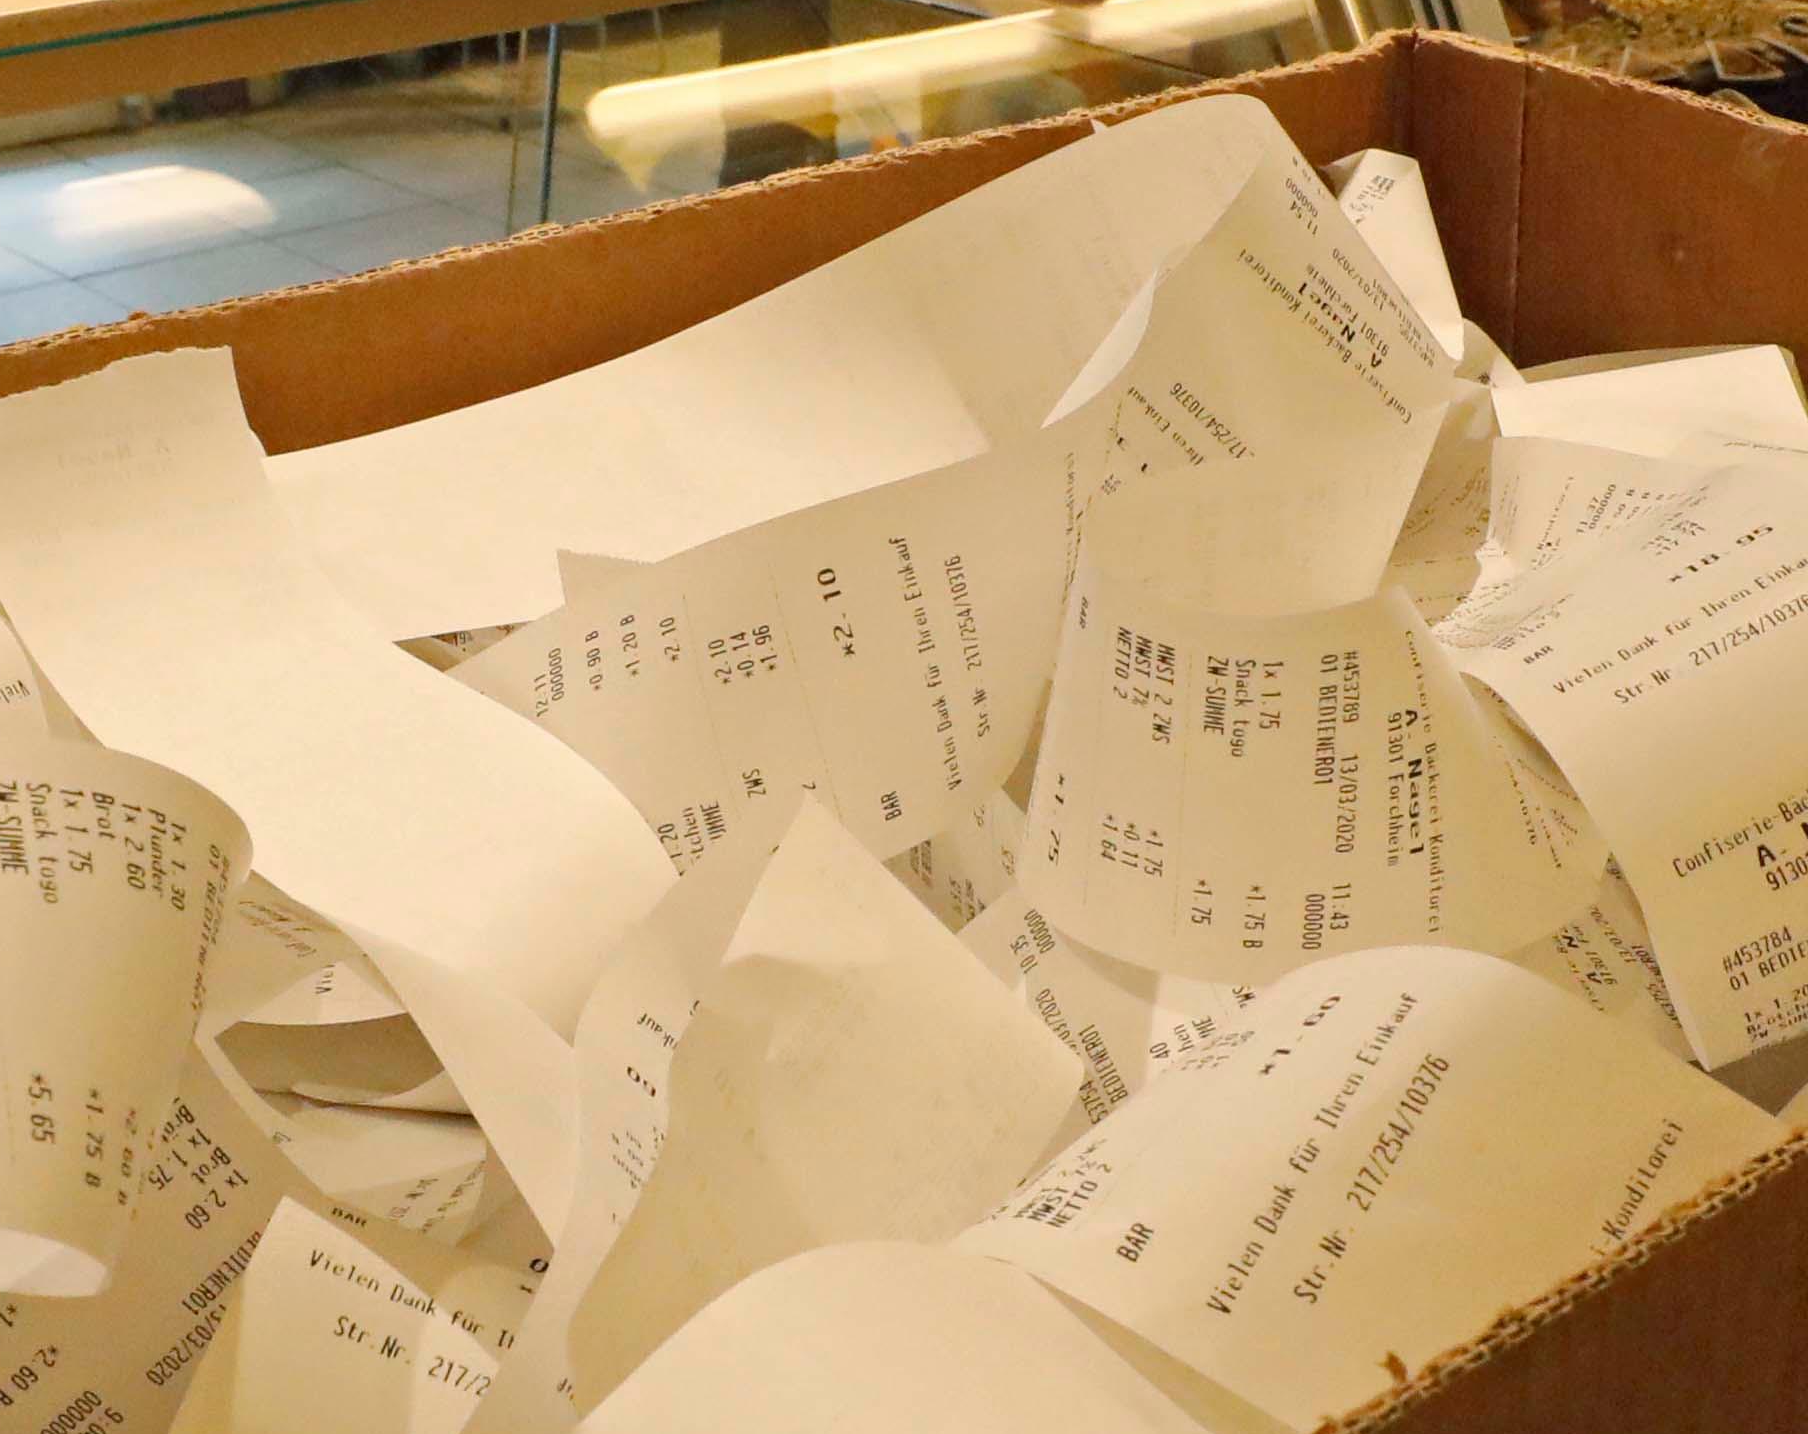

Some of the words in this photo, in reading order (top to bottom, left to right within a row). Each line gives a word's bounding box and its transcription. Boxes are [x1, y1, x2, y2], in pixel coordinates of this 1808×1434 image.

[887, 535, 925, 600] Einkauf
[908, 604, 934, 652] Ihren
[940, 553, 987, 669] 217/254/10376
[1521, 642, 1554, 667] BAR
[1553, 655, 1613, 698] Vielen
[1616, 632, 1661, 666] Dank
[1664, 612, 1696, 647] für
[1701, 587, 1750, 623] Ihren
[549, 647, 567, 702] 000000
[1200, 655, 1230, 738] ZW-SUMME
[1233, 658, 1257, 716] Snack
[1342, 650, 1362, 725] #453789
[932, 694, 955, 735] Dank
[1228, 725, 1248, 759] togo
[1314, 681, 1337, 786] BEDIENER01
[1387, 711, 1406, 770] 91301
[940, 734, 964, 791] Vielen
[91, 792, 114, 840] Brot
[879, 788, 904, 822] BAR
[1333, 753, 1360, 856] 13/03/2020
[1386, 777, 1402, 868] Forchheim
[1406, 759, 1426, 858] Nagel
[27, 781, 52, 840] Snack
[42, 851, 60, 905] togo
[148, 808, 170, 900] Plunder
[1300, 893, 1326, 952] 000000
[1721, 927, 1793, 976] #453784
[1728, 967, 1756, 992] 01
[1208, 1245, 1269, 1319] Vielen
[1253, 1173, 1298, 1239] Dank
[1289, 1125, 1323, 1169] für
[1312, 1072, 1364, 1131] Ihren
[1358, 990, 1420, 1069] Einkauf
[1345, 1053, 1453, 1212] 217/254/10376
[198, 1145, 233, 1184] Brot
[1117, 1219, 1158, 1265] BAR
[309, 1249, 380, 1295] Vielen
[387, 1284, 440, 1317] Dank
[450, 1310, 487, 1337] für
